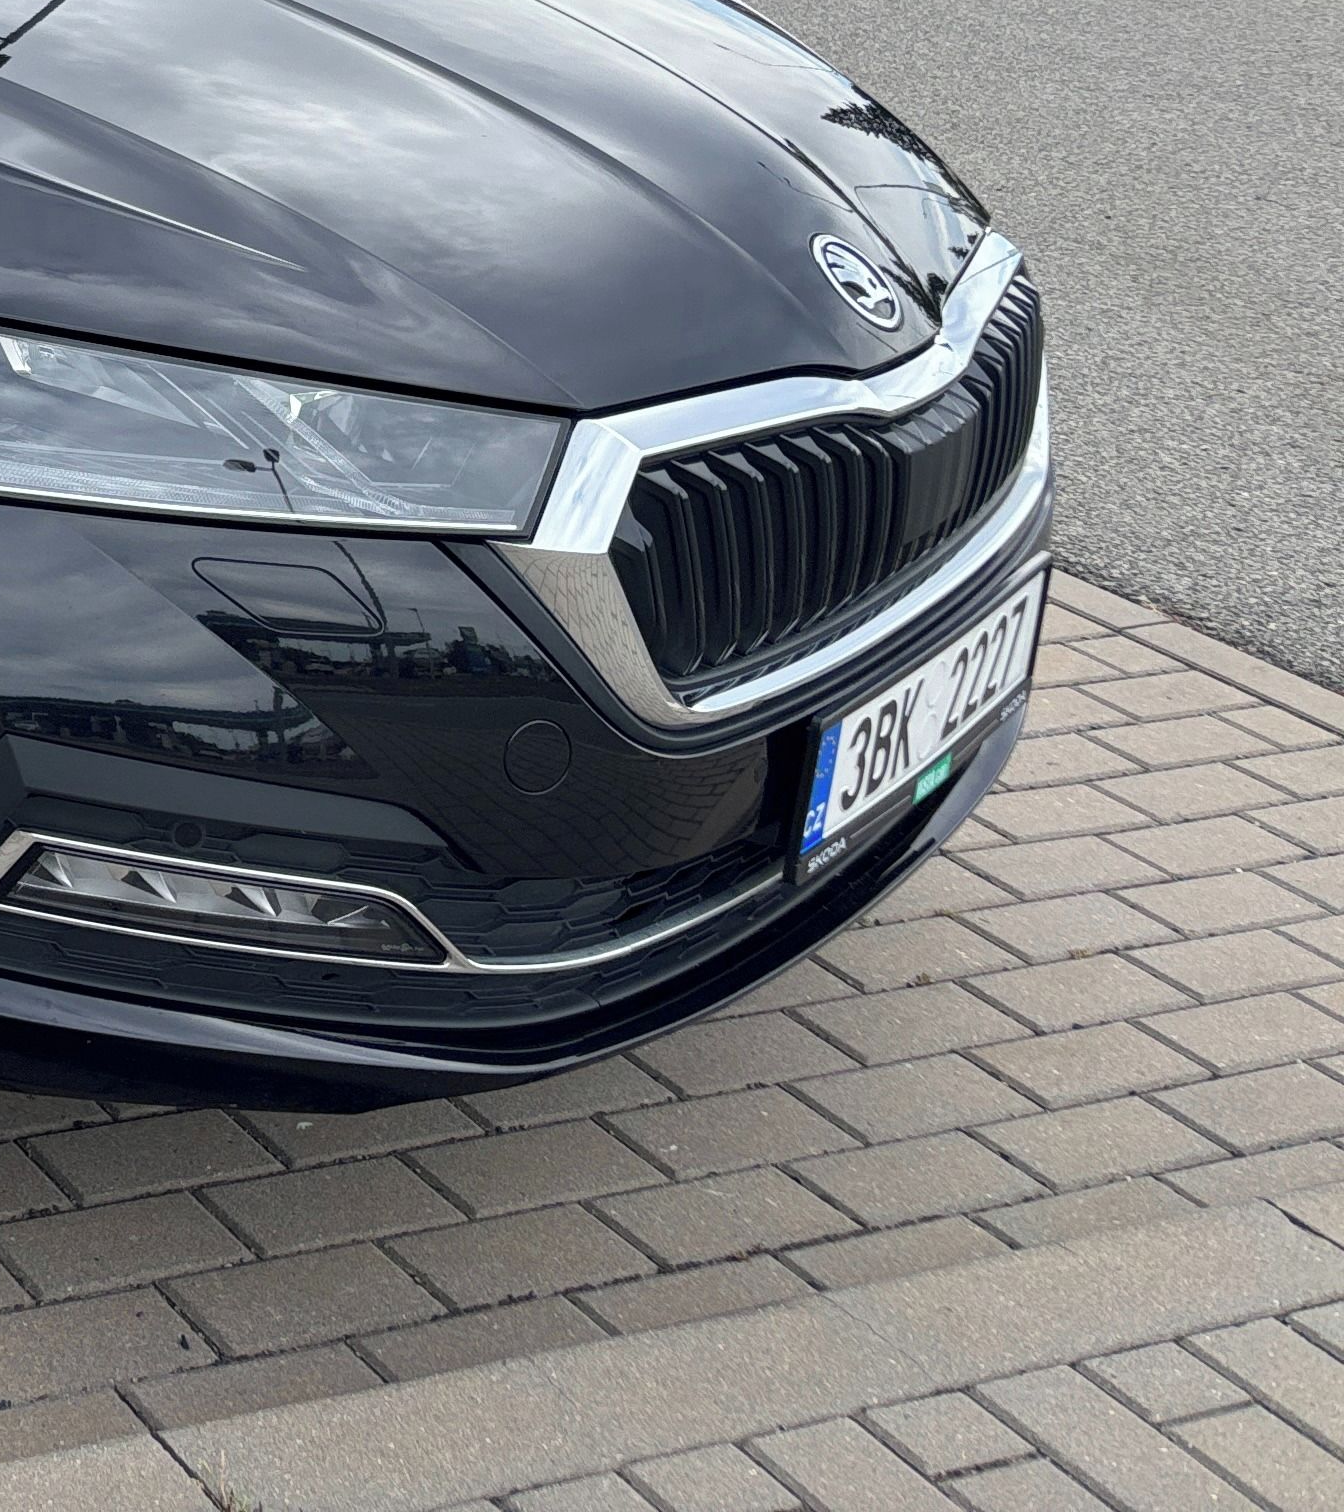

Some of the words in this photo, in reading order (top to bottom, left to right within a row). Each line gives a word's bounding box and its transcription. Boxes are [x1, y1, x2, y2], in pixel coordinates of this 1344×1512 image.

[840, 678, 925, 811] 3BK
[940, 592, 1029, 739] 2227
[803, 802, 826, 838] CZ
